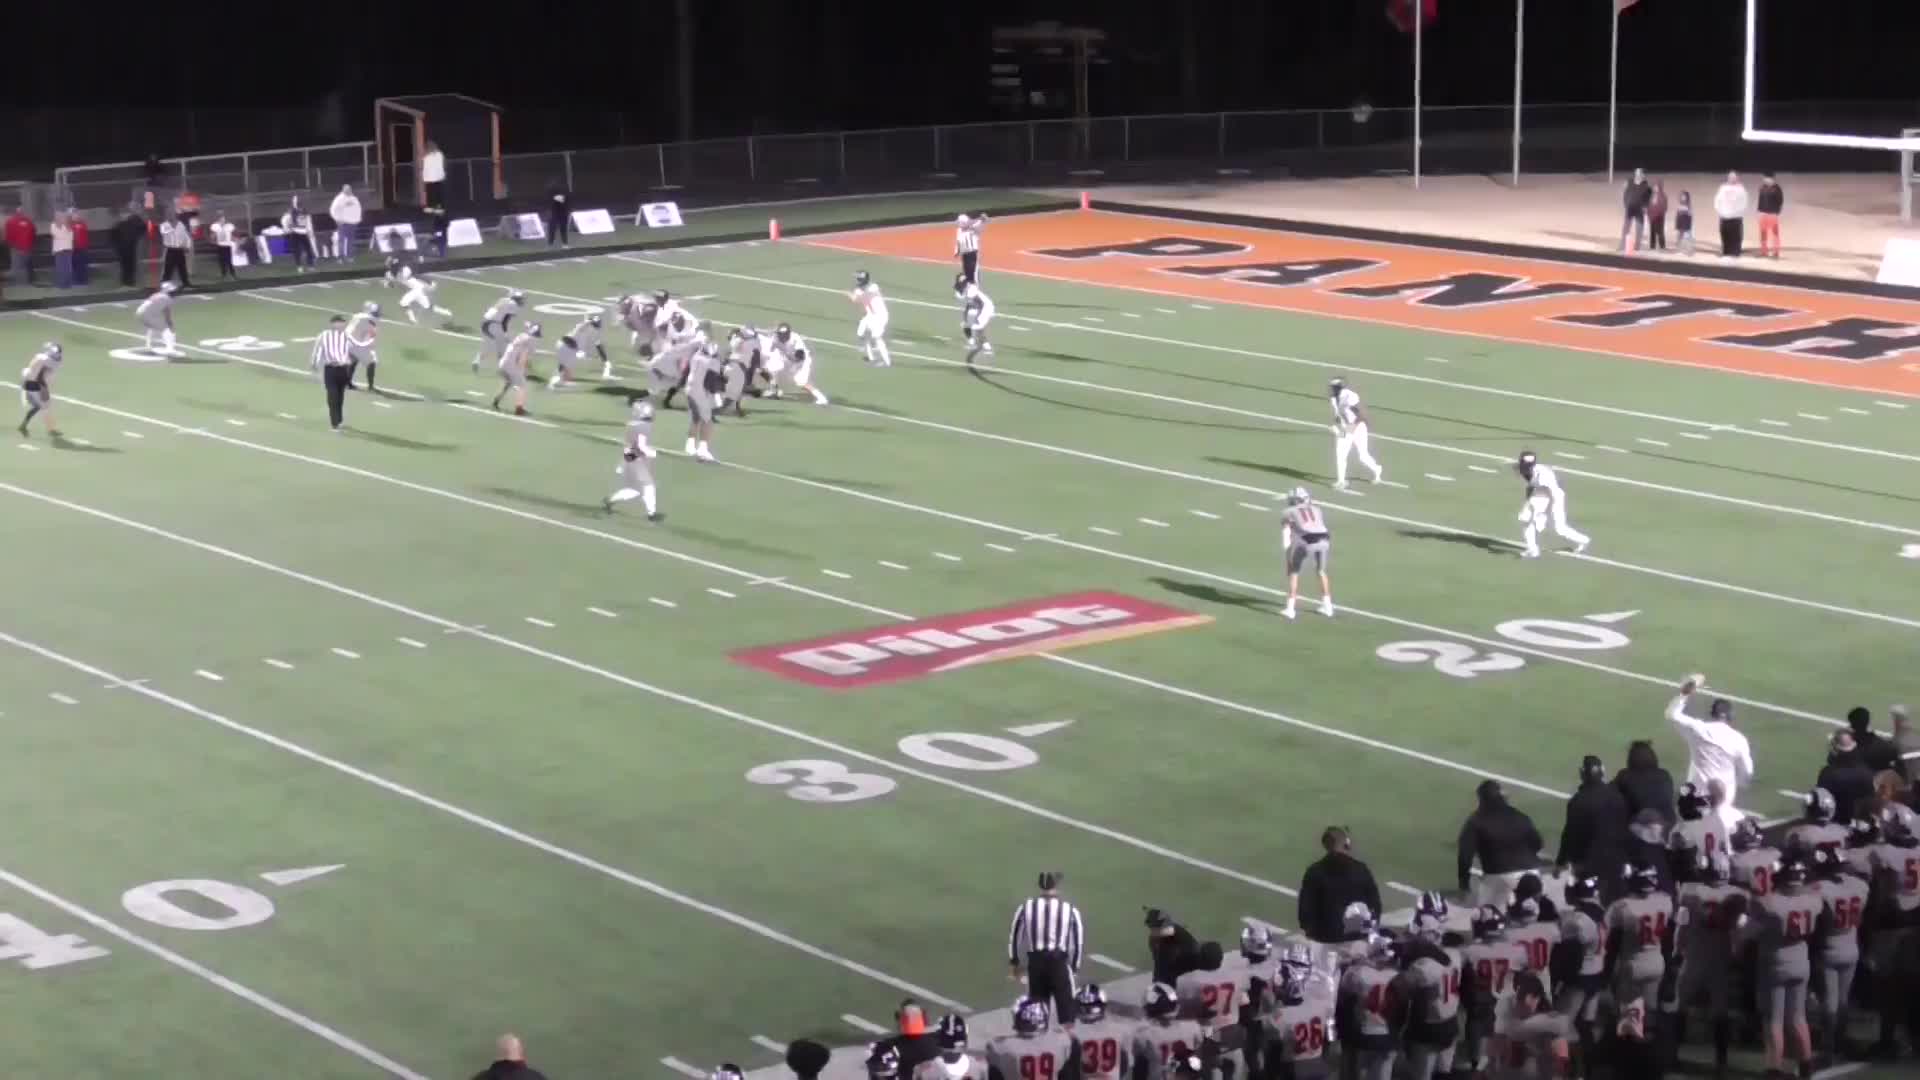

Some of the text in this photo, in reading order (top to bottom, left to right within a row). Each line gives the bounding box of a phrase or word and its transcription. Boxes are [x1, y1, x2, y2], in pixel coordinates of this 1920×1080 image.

[744, 731, 1039, 803] 30
[1200, 981, 1236, 1016] 27
[1081, 1037, 1118, 1075] 39
